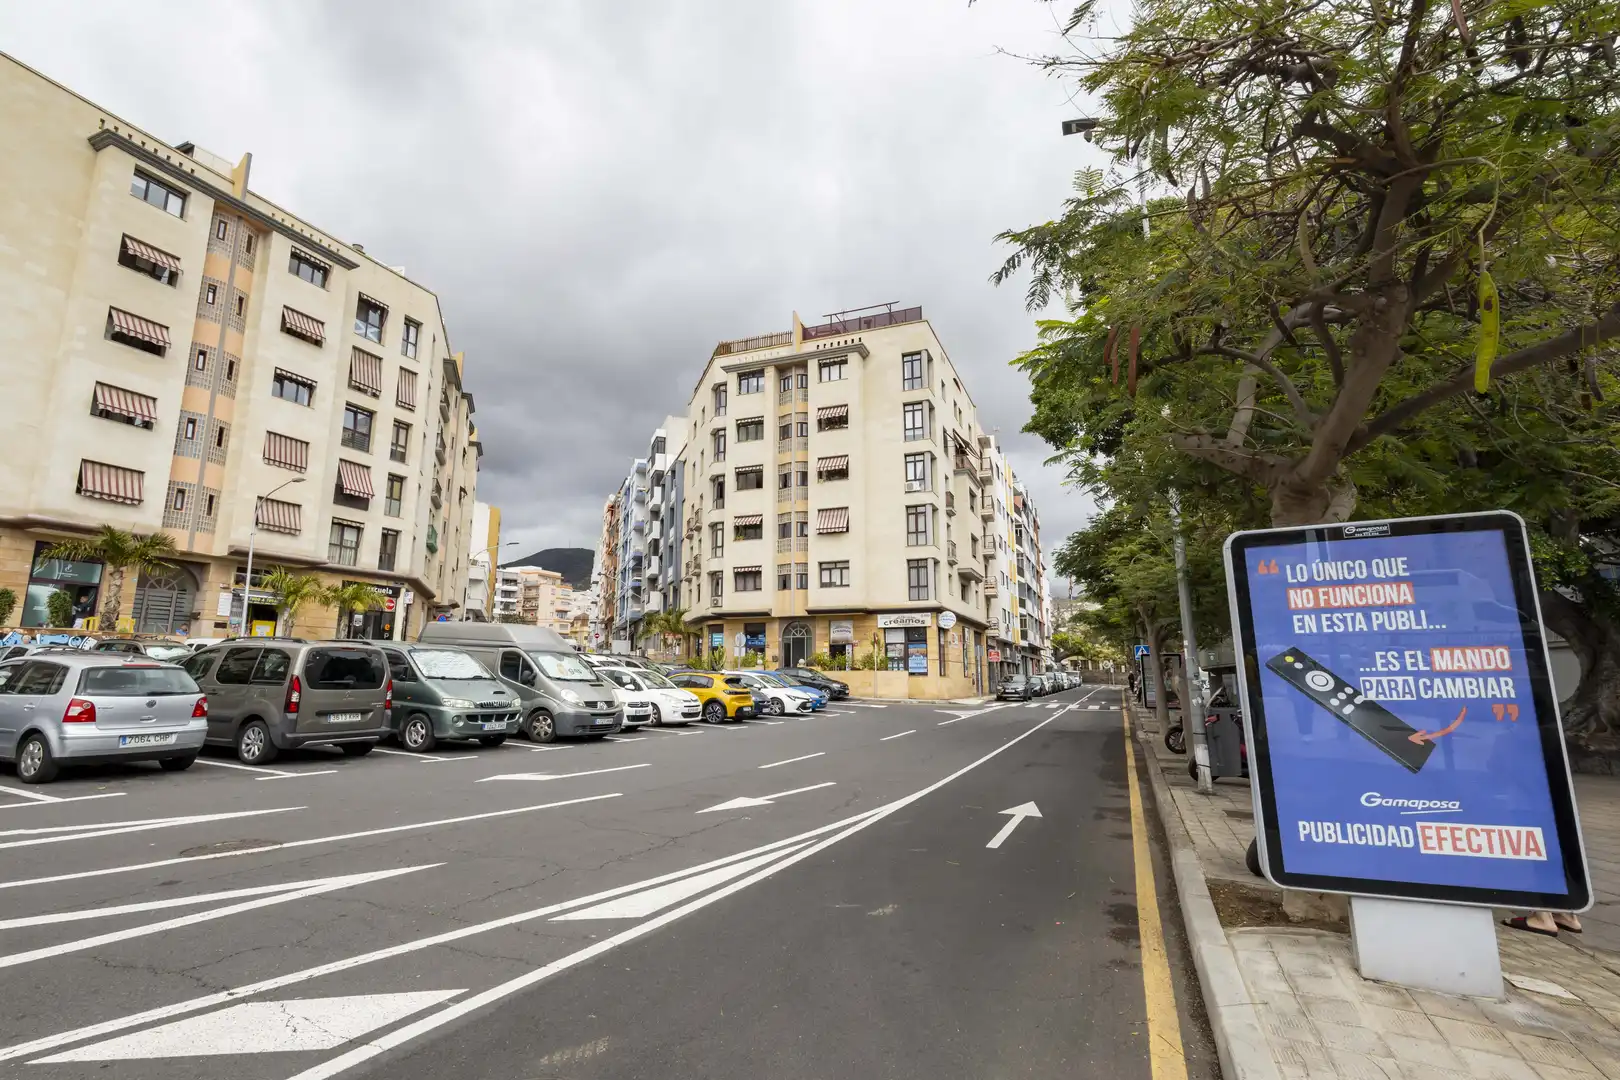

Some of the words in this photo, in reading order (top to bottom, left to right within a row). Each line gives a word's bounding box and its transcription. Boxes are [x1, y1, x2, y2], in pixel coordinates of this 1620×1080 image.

[1286, 563, 1308, 583] LO
[1312, 559, 1366, 582] ÚNICO
[1371, 557, 1410, 579] QUE
[1288, 588, 1314, 608] NO
[1318, 583, 1413, 607] FUNCIONA
[1292, 613, 1317, 634] EN
[1321, 612, 1368, 633] ESTA
[1371, 609, 1447, 632] PUBLI...
[1359, 650, 1401, 672] ...ES
[1404, 650, 1430, 671] EL
[1432, 648, 1510, 670] MANDO
[1361, 678, 1415, 699] PARA
[1418, 677, 1516, 699] CAMBIAR
[128, 735, 151, 744] 7064
[154, 734, 170, 742] CHP
[1360, 792, 1460, 810] Gamaposa
[1298, 820, 1414, 848] PUBLICIDAD
[1420, 824, 1543, 857] EFECTIVA
